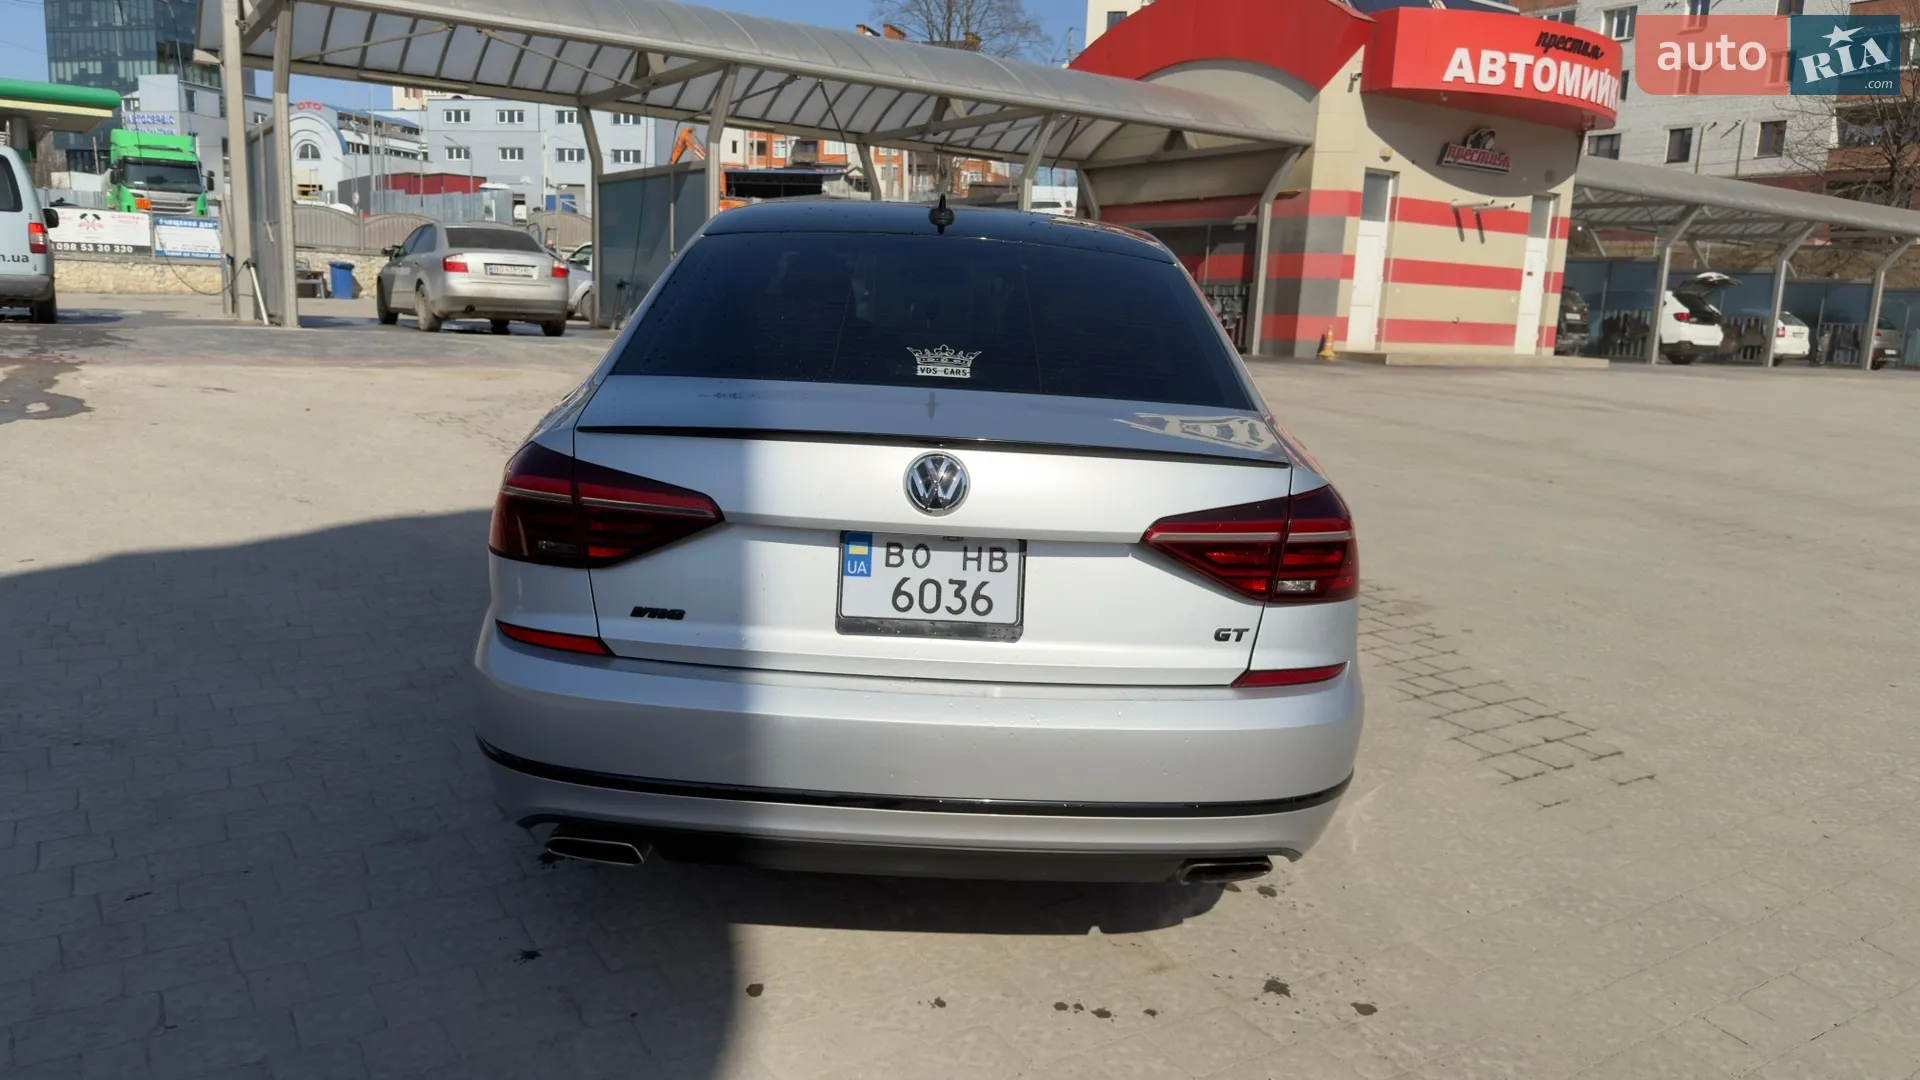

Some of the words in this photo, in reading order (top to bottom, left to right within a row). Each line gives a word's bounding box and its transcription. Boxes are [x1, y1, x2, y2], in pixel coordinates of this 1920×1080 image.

[56, 242, 77, 251] 098
[81, 243, 94, 252] 53
[97, 244, 111, 252] 30
[114, 245, 133, 253] 330
[920, 367, 938, 375] VDS
[943, 368, 968, 376] CARS
[885, 542, 931, 569] BO
[962, 545, 1009, 573] HB
[847, 560, 868, 575] UA
[891, 576, 994, 617] 6036
[1213, 627, 1251, 643] GT
